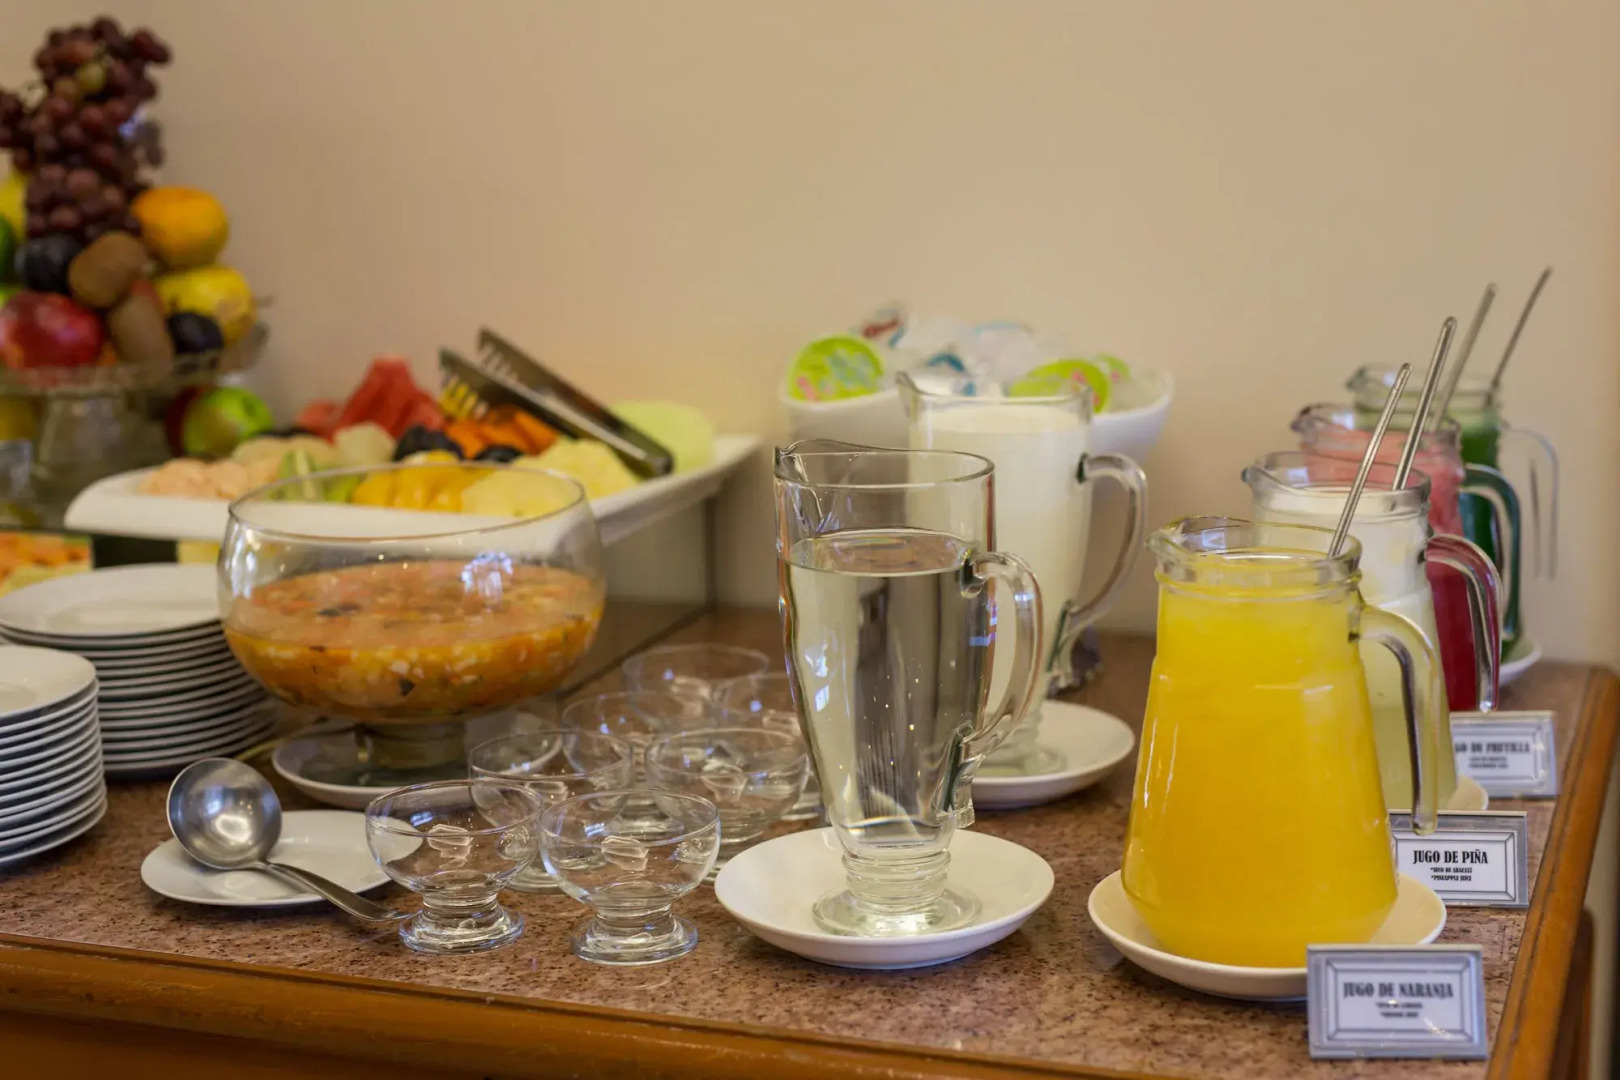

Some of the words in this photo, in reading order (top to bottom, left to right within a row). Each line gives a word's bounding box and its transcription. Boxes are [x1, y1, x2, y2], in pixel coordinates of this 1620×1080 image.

[1413, 850, 1441, 864] JUGO
[1444, 851, 1459, 864] DE
[1462, 849, 1488, 864] PIÑA
[1343, 982, 1374, 998] JUGO
[1378, 982, 1394, 997] DE
[1399, 983, 1454, 999] NARANJA
